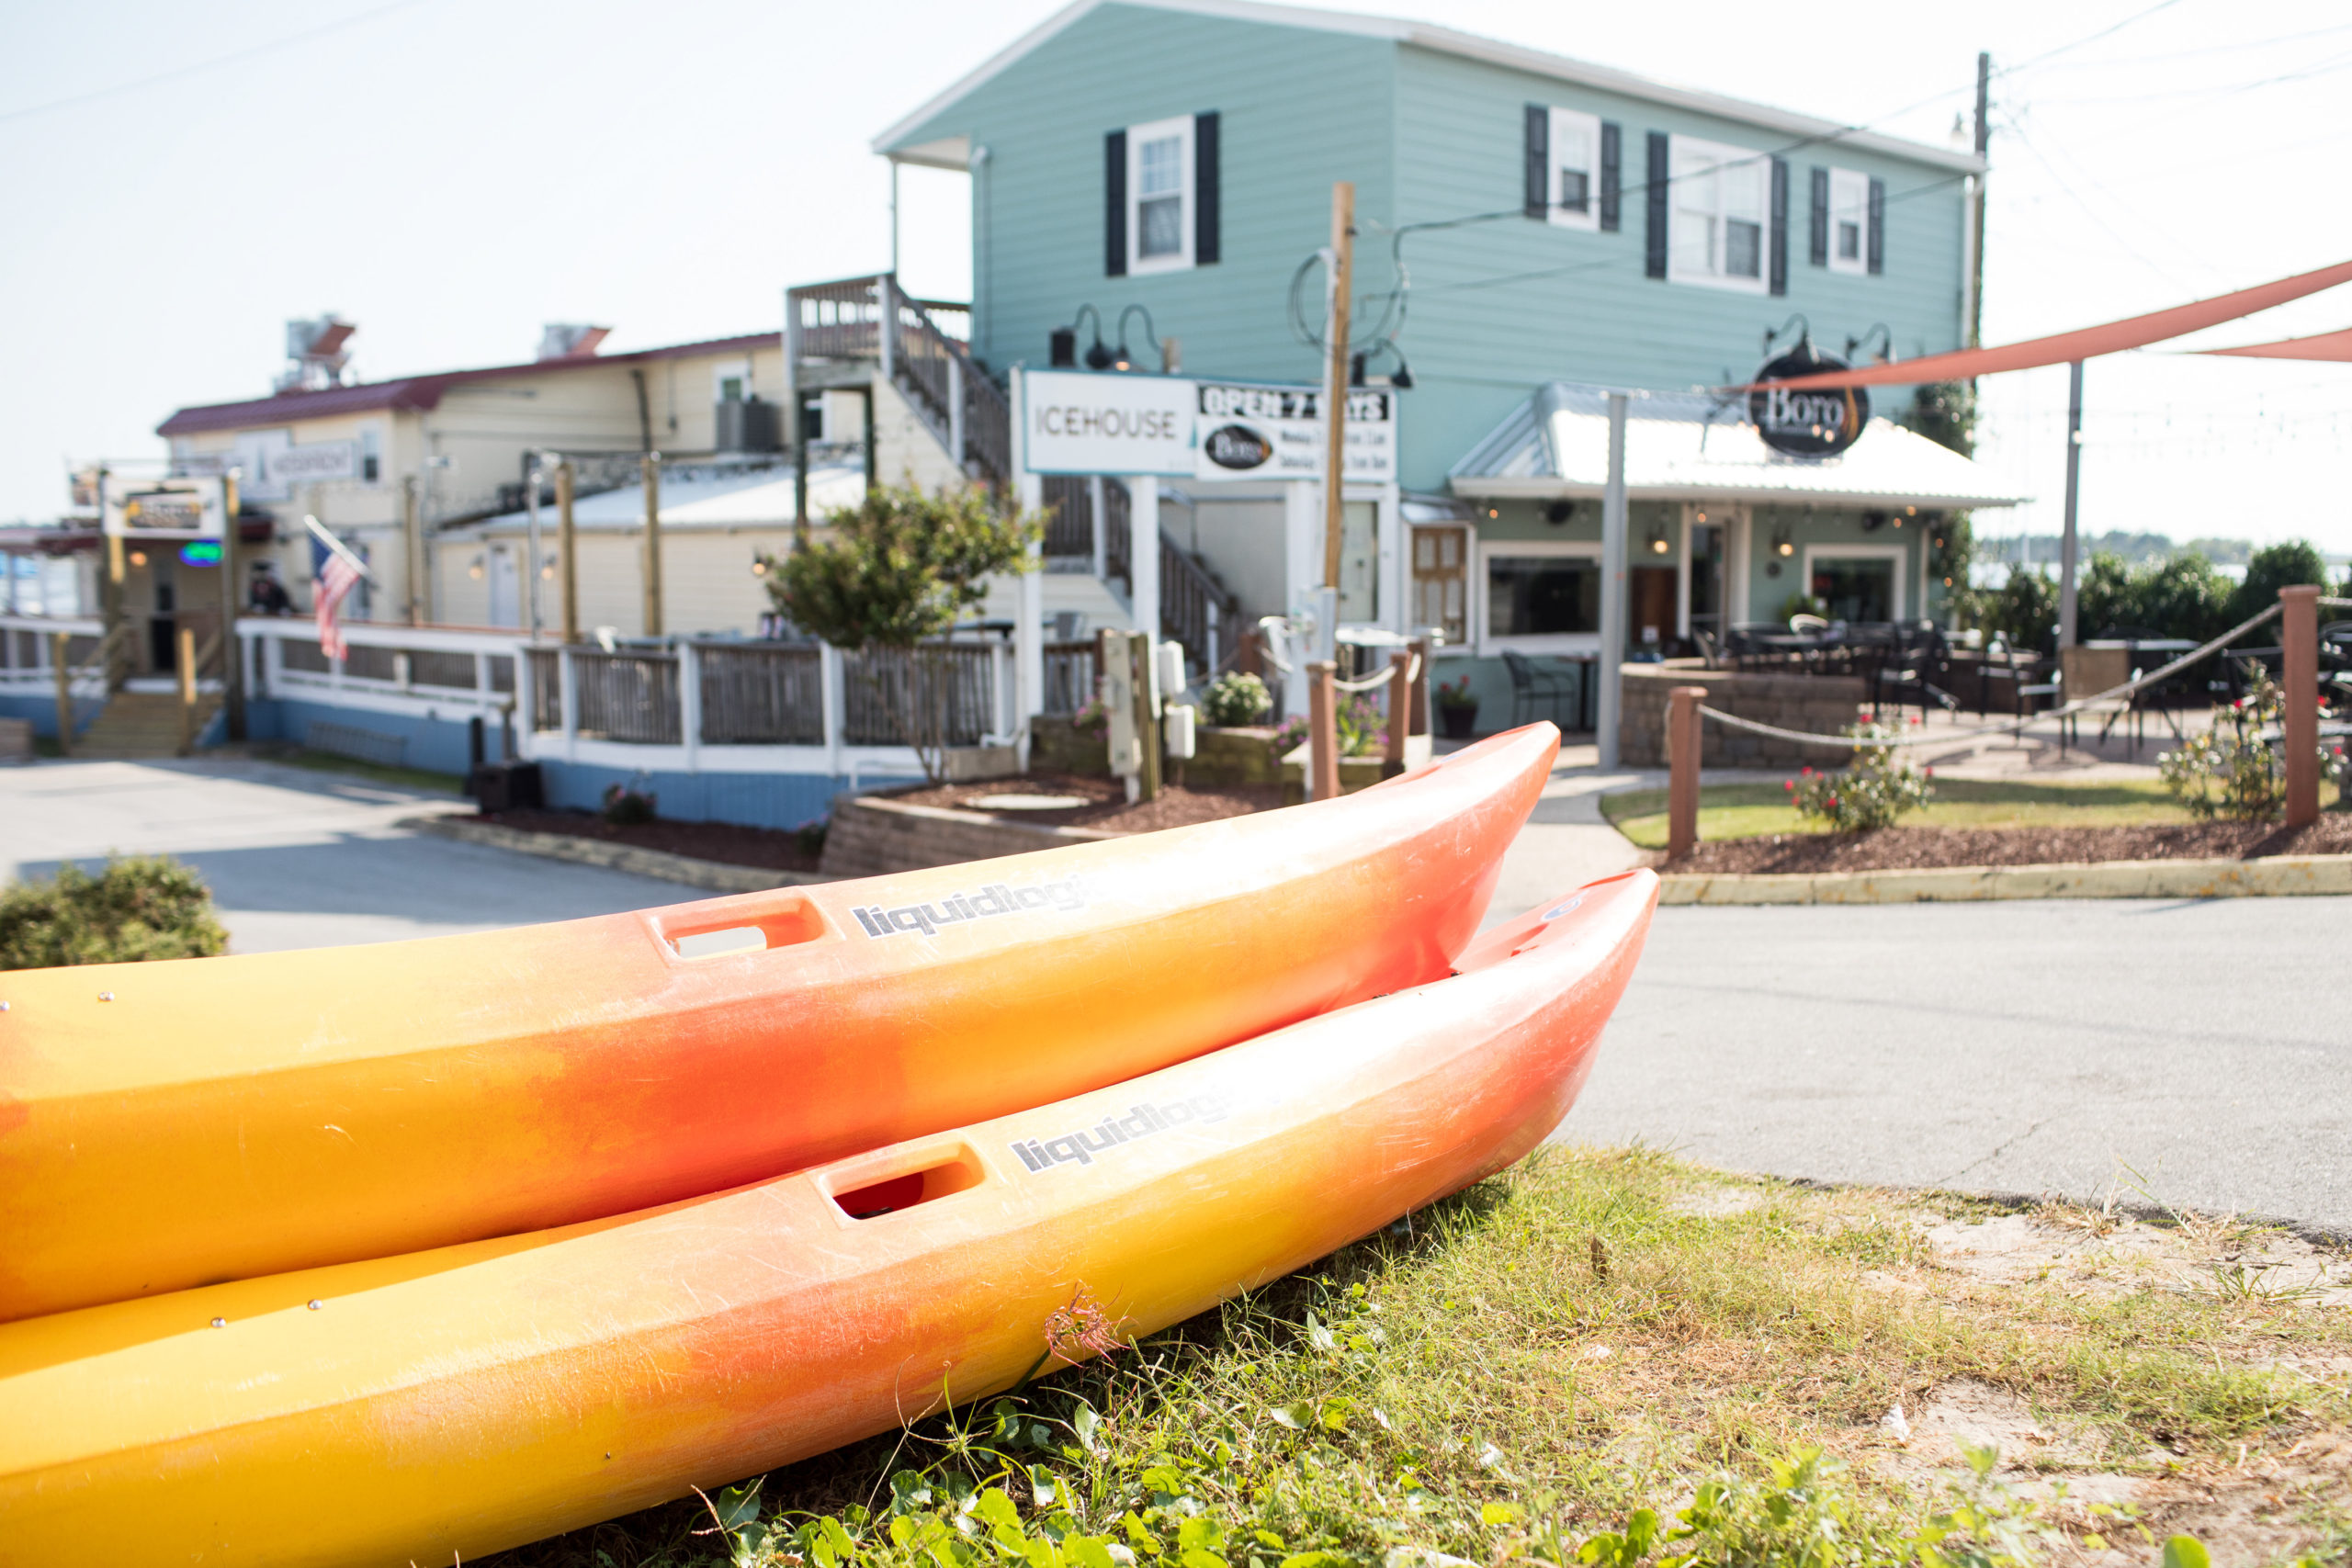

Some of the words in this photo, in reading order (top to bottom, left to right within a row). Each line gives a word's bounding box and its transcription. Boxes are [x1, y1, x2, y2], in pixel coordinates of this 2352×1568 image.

[1035, 405, 1177, 439] ICEHOUSE
[1204, 387, 1282, 418] OPEN
[1288, 391, 1306, 419] 7
[1763, 377, 1845, 426] Boro
[853, 875, 1097, 938] liquidlog
[1011, 1084, 1234, 1172] liquidlog
